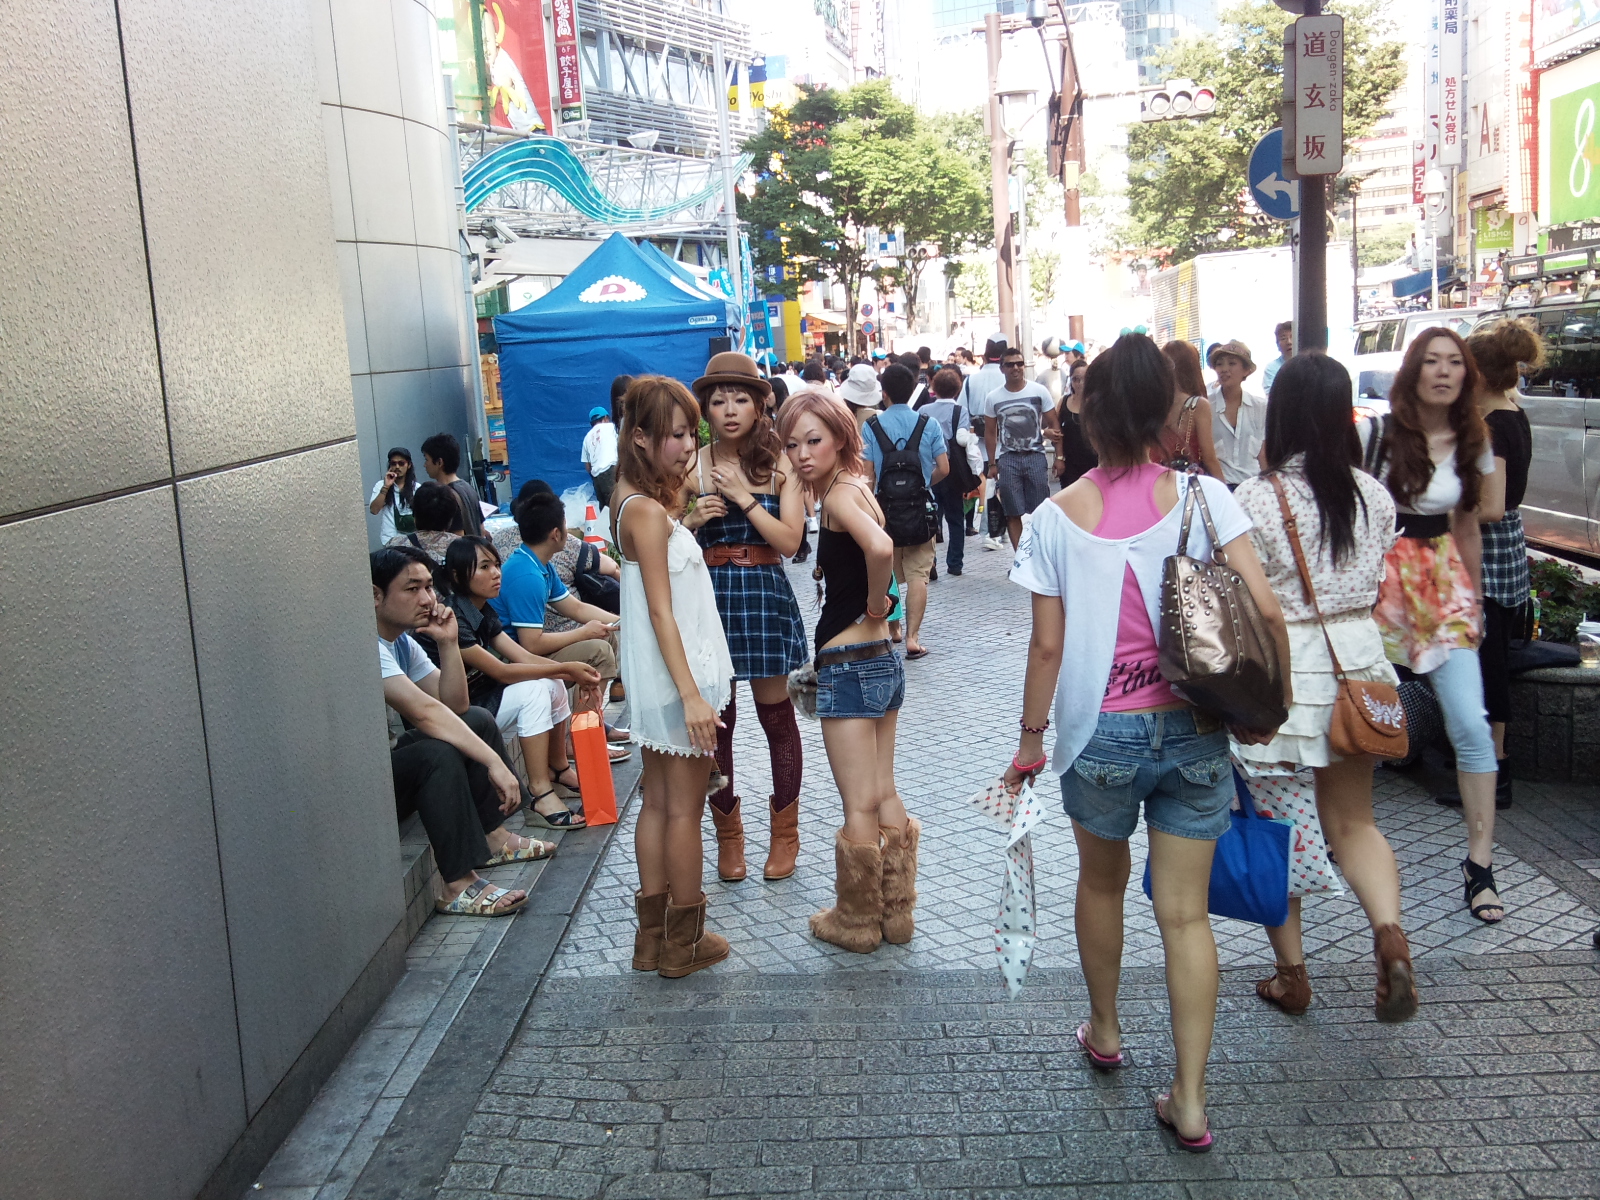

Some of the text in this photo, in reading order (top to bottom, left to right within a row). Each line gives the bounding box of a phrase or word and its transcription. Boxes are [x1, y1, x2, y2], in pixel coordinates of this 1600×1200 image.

[559, 55, 574, 99] 餃子屋台
[1303, 31, 1326, 160] 道玄坂
[1327, 30, 1340, 112] Dougen-zaka
[1445, 77, 1457, 145] 処方せん受付
